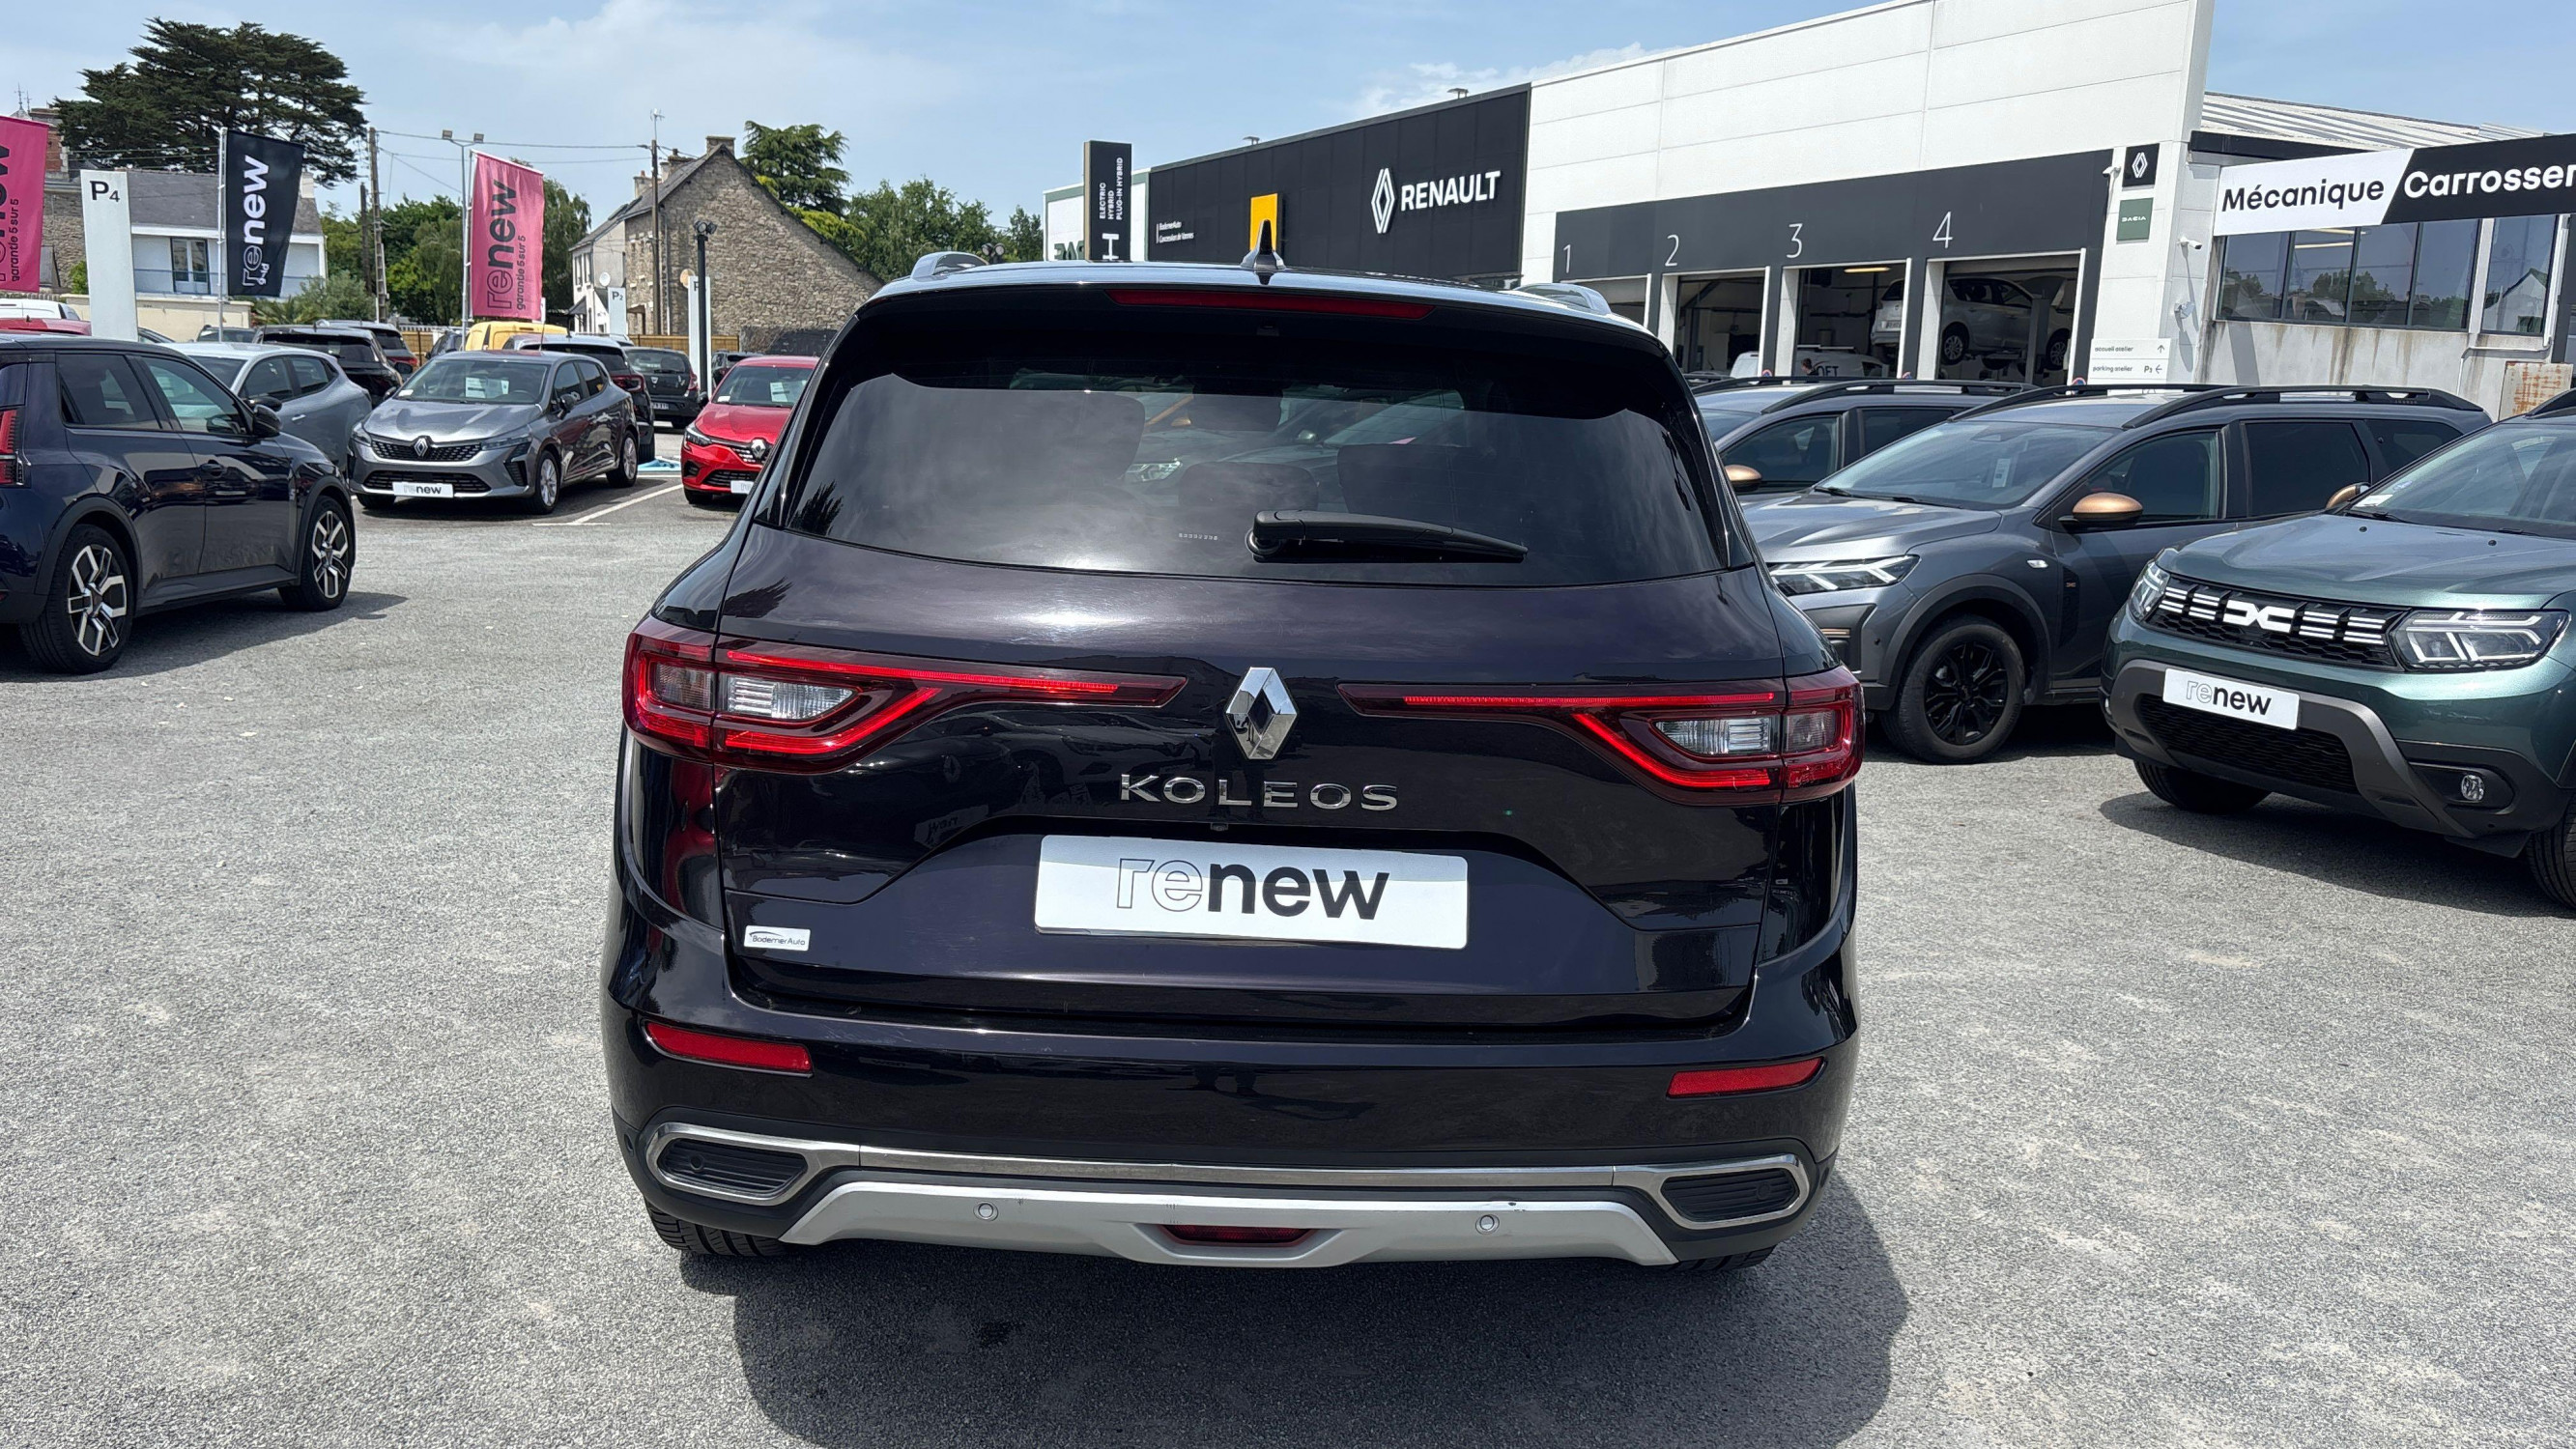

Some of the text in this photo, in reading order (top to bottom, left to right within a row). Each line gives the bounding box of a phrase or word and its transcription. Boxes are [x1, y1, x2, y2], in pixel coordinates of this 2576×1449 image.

[89, 180, 121, 203] P4
[1400, 170, 1501, 212] RENAULT
[2222, 179, 2385, 212] Mécanique
[10, 207, 18, 225] sur
[243, 155, 270, 286] renew
[1932, 211, 1954, 249] 4
[8, 236, 19, 282] garantie
[487, 180, 517, 309] renew
[1562, 243, 1572, 273] 1
[1665, 235, 1679, 267] 2
[1787, 223, 1804, 259] 3
[516, 269, 526, 310] garantie
[2186, 680, 2272, 715] renew
[1120, 774, 1398, 811] KOLEOS
[1116, 858, 1390, 921] renew
